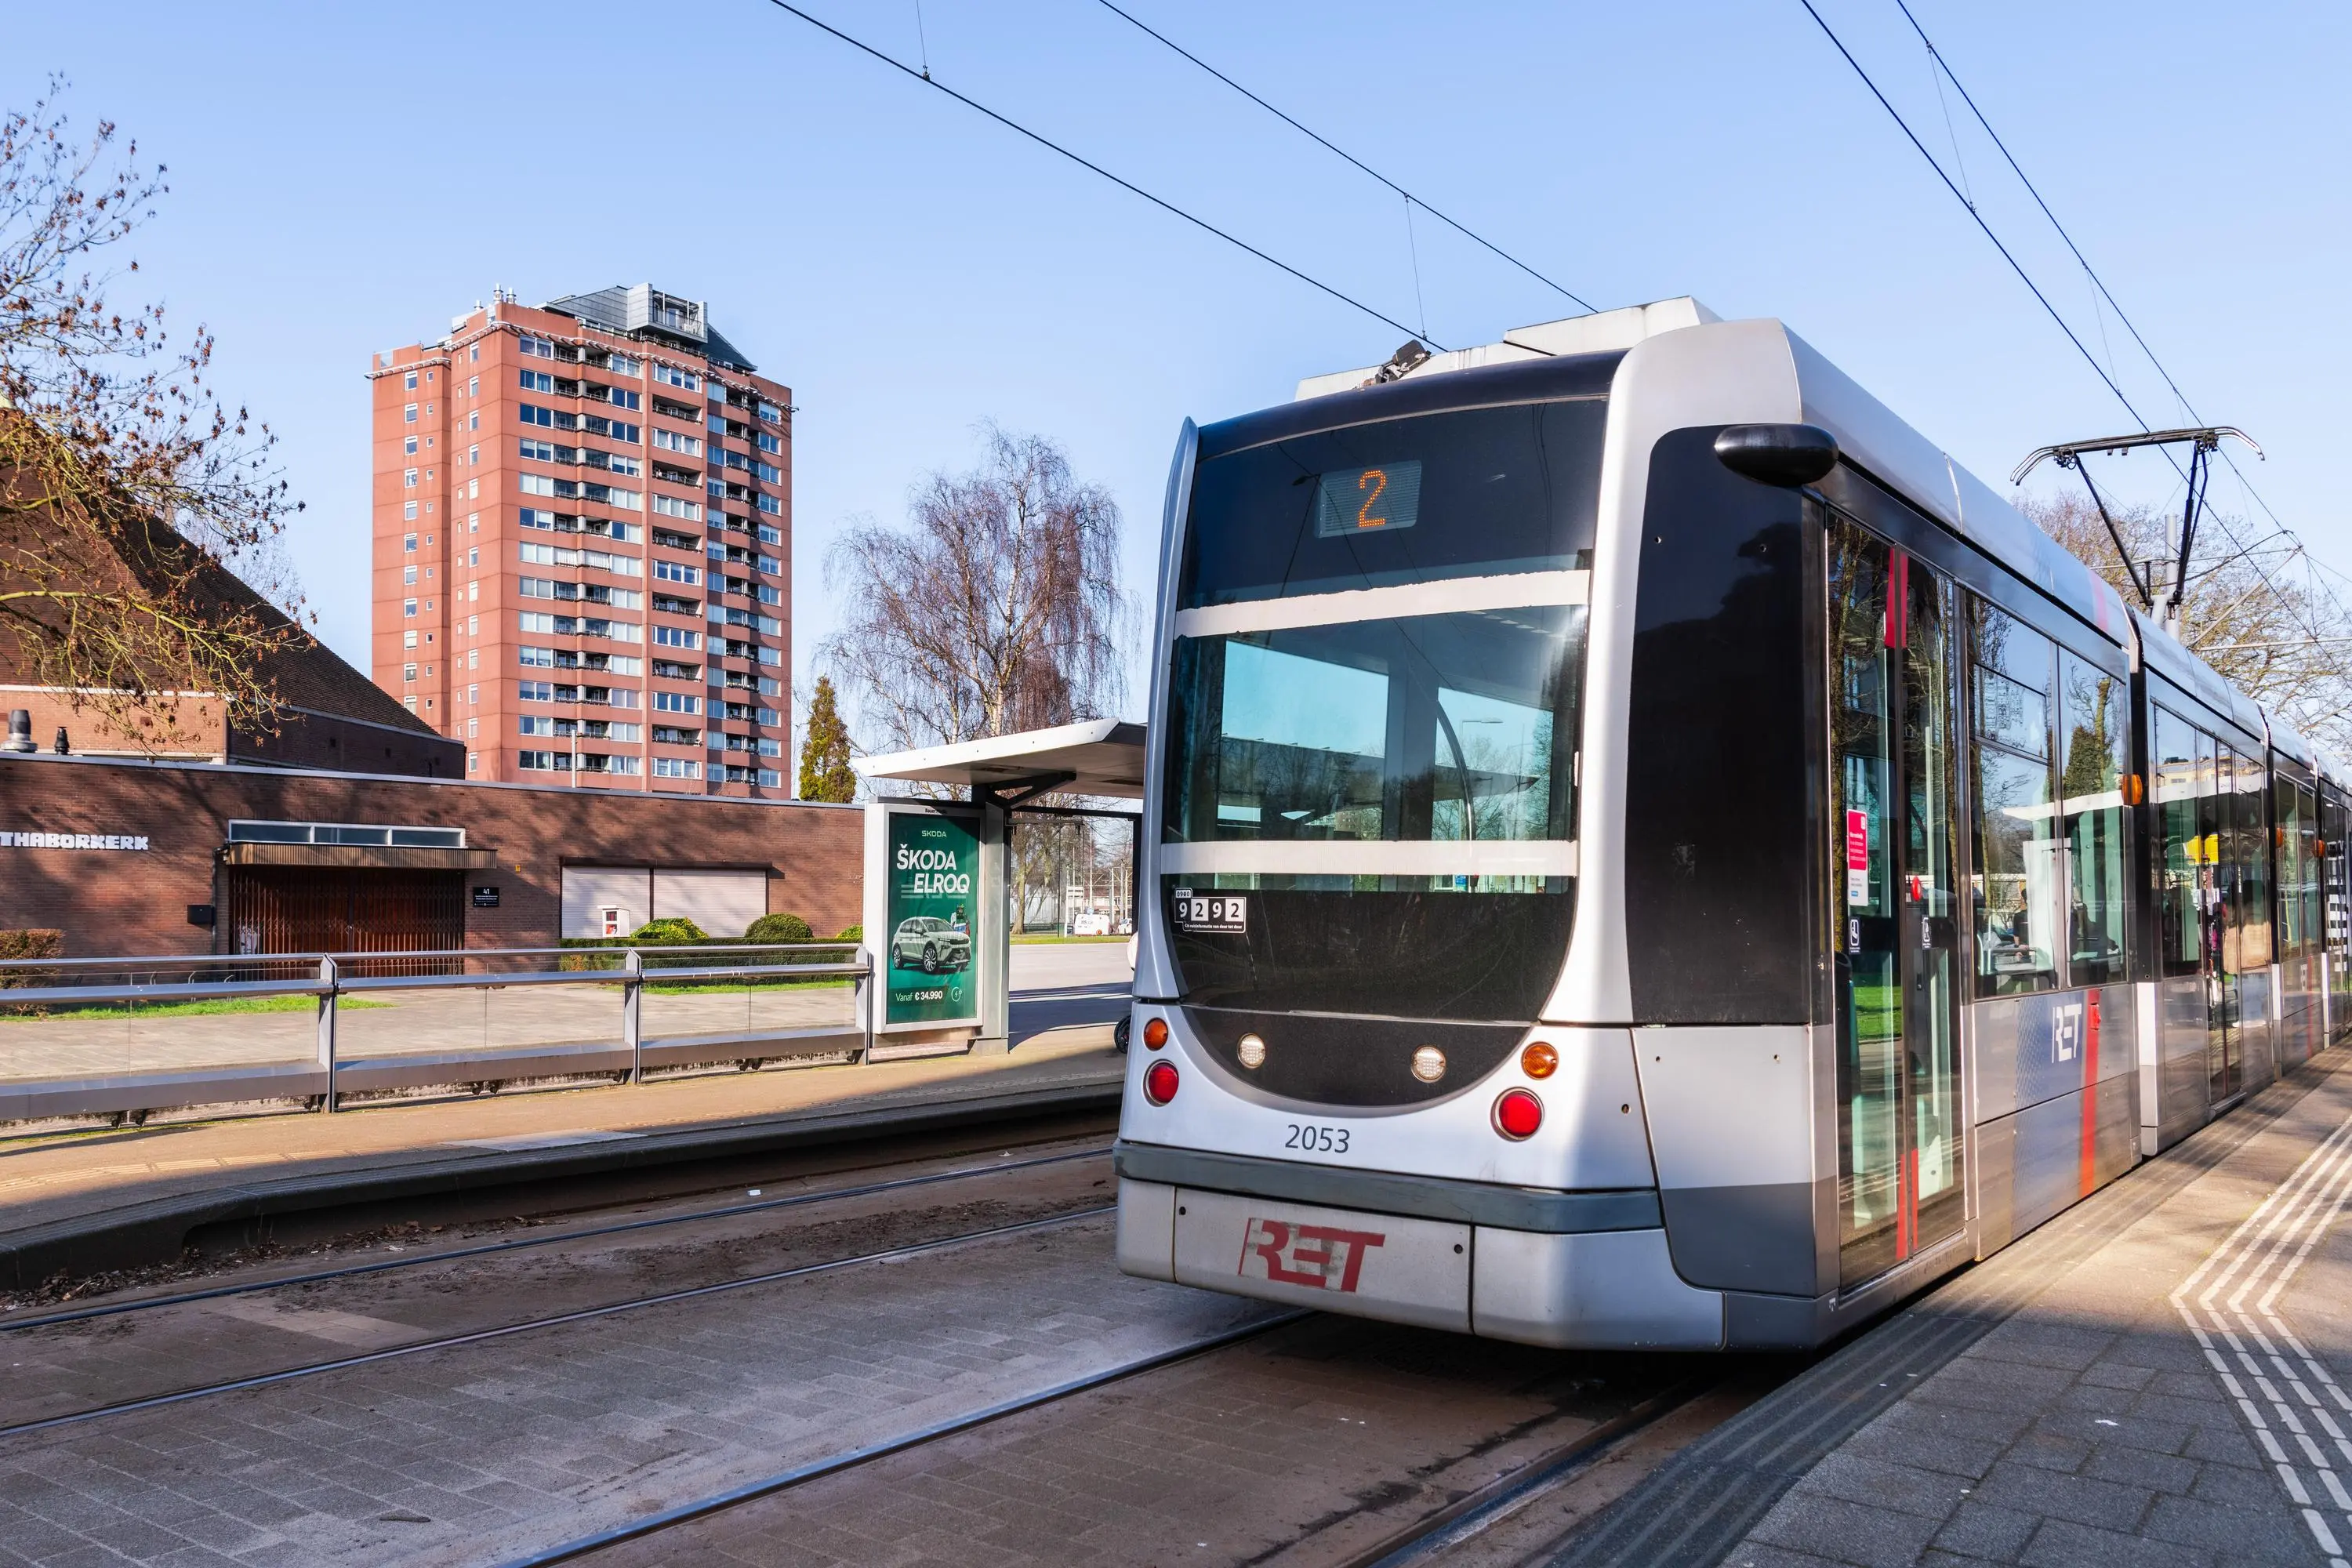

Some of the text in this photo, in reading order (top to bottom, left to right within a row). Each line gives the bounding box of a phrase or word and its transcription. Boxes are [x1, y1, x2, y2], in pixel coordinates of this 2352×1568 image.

[1359, 470, 1386, 527] 2
[0, 832, 148, 850] THABORKERK
[896, 844, 956, 870] ŠKODA
[913, 873, 971, 894] ELROQ
[1179, 902, 1240, 919] 9292
[895, 990, 943, 1002] Vanaf € 34.990
[2052, 1004, 2082, 1063] RET
[1285, 1124, 1350, 1153] 2053
[1238, 1218, 1386, 1293] RET
